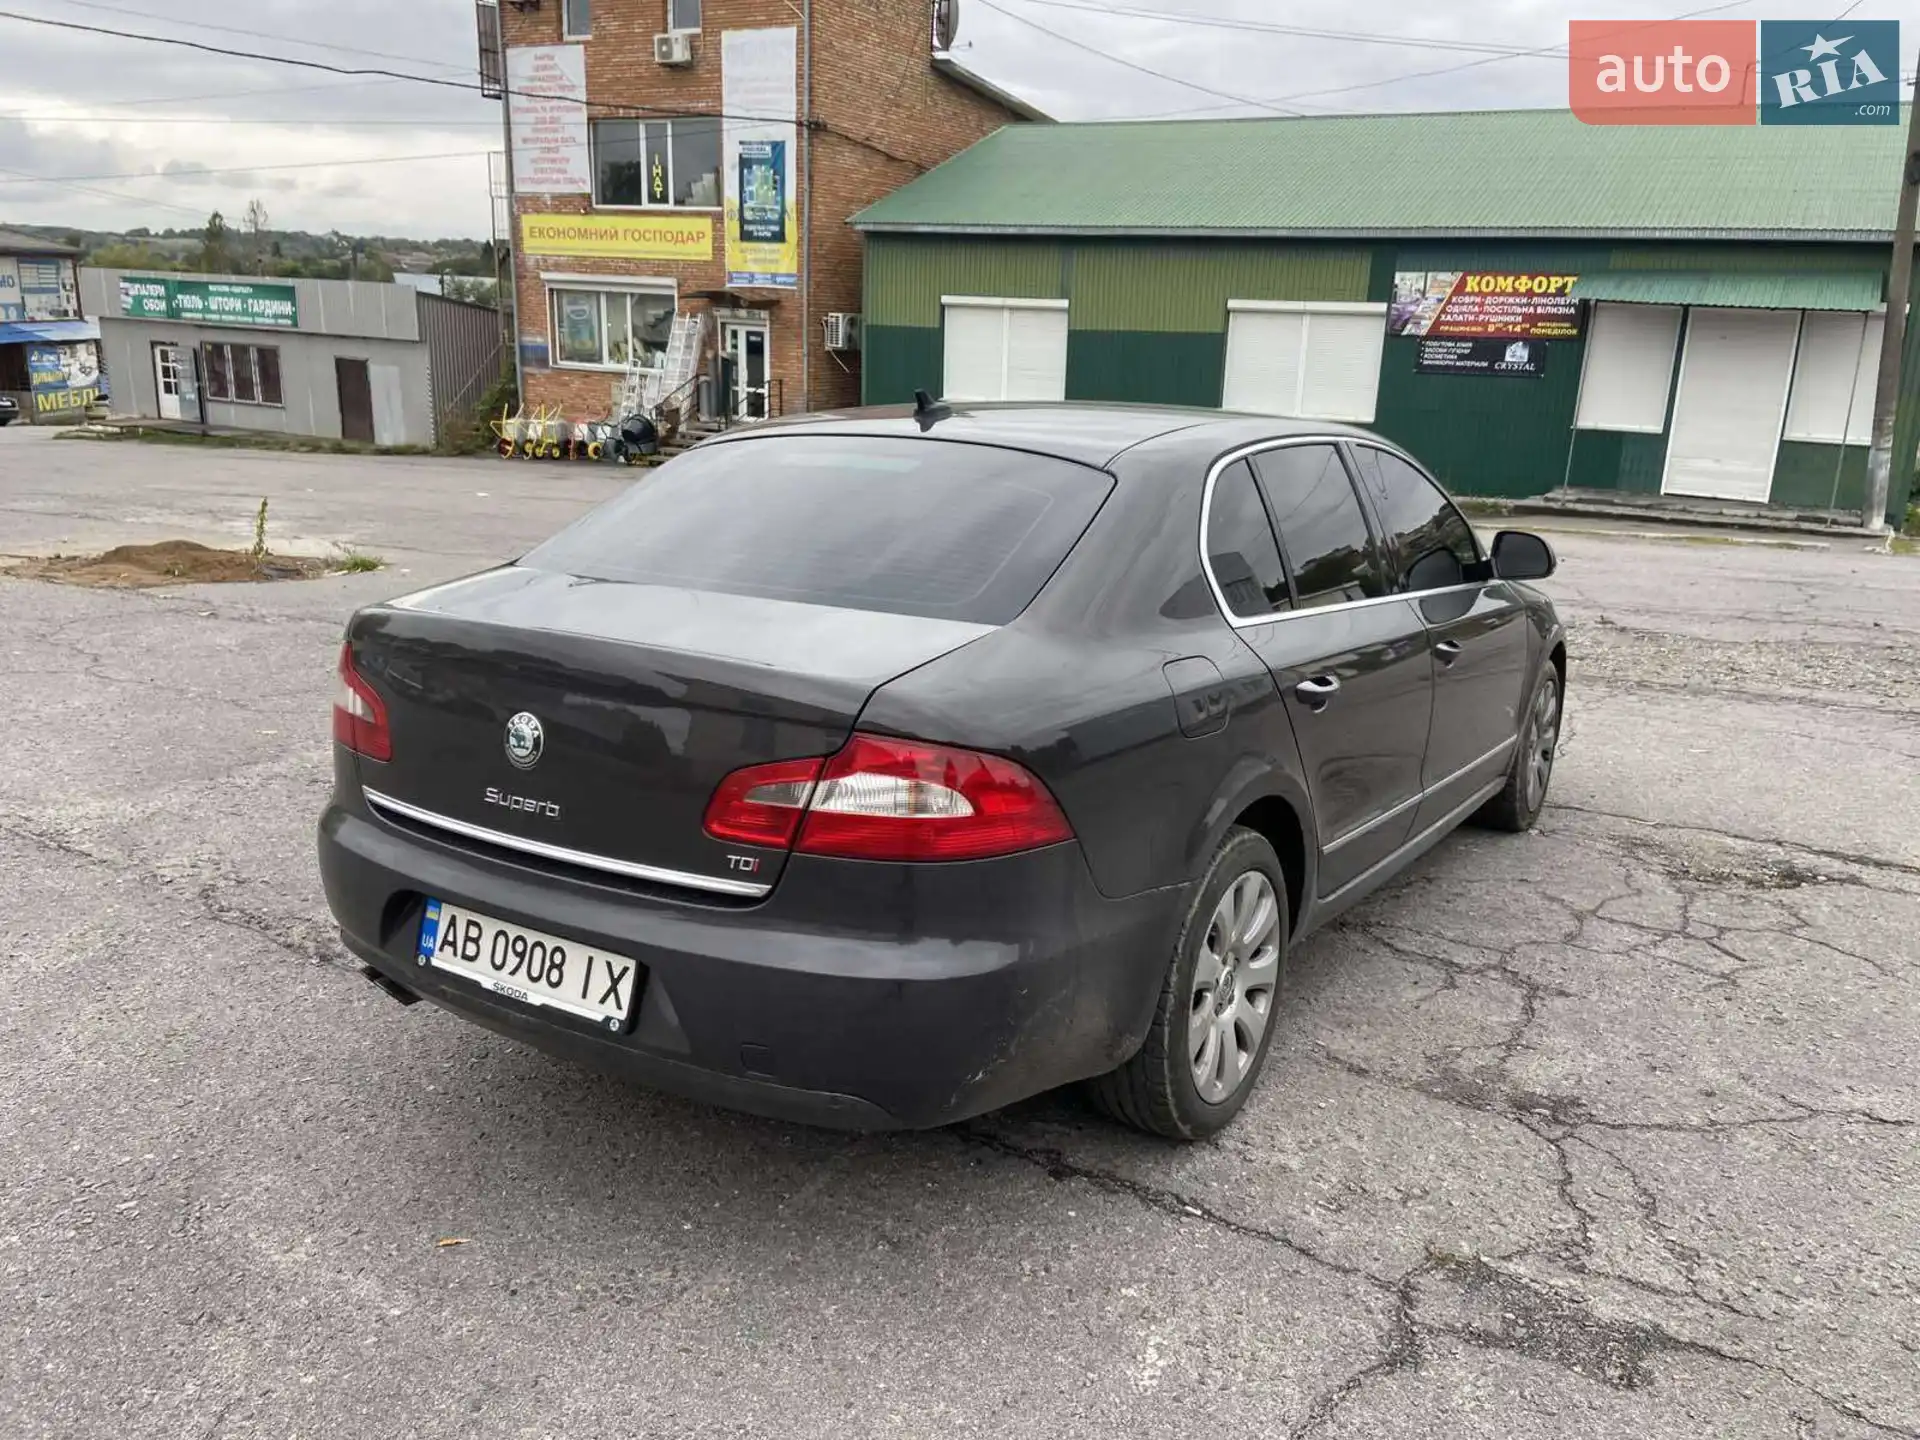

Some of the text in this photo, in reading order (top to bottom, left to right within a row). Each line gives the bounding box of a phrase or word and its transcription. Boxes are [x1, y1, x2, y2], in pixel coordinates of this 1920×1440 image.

[529, 226, 706, 245] ЕКОНОМНИЙ ГОСПОДАР
[1465, 275, 1579, 295] КОМФОРТ
[176, 294, 292, 317] ТЮЛЬ ШТОРИ ГАРДИНИ
[1483, 306, 1534, 314] ПОСТІЛЬНА
[1440, 314, 1523, 323] ХАЛАТИ РУШНИКИ
[1494, 361, 1536, 371] CRYSTAL
[484, 787, 560, 817] Superb
[421, 935, 434, 949] UA
[439, 914, 630, 1010] AB 0908 IX
